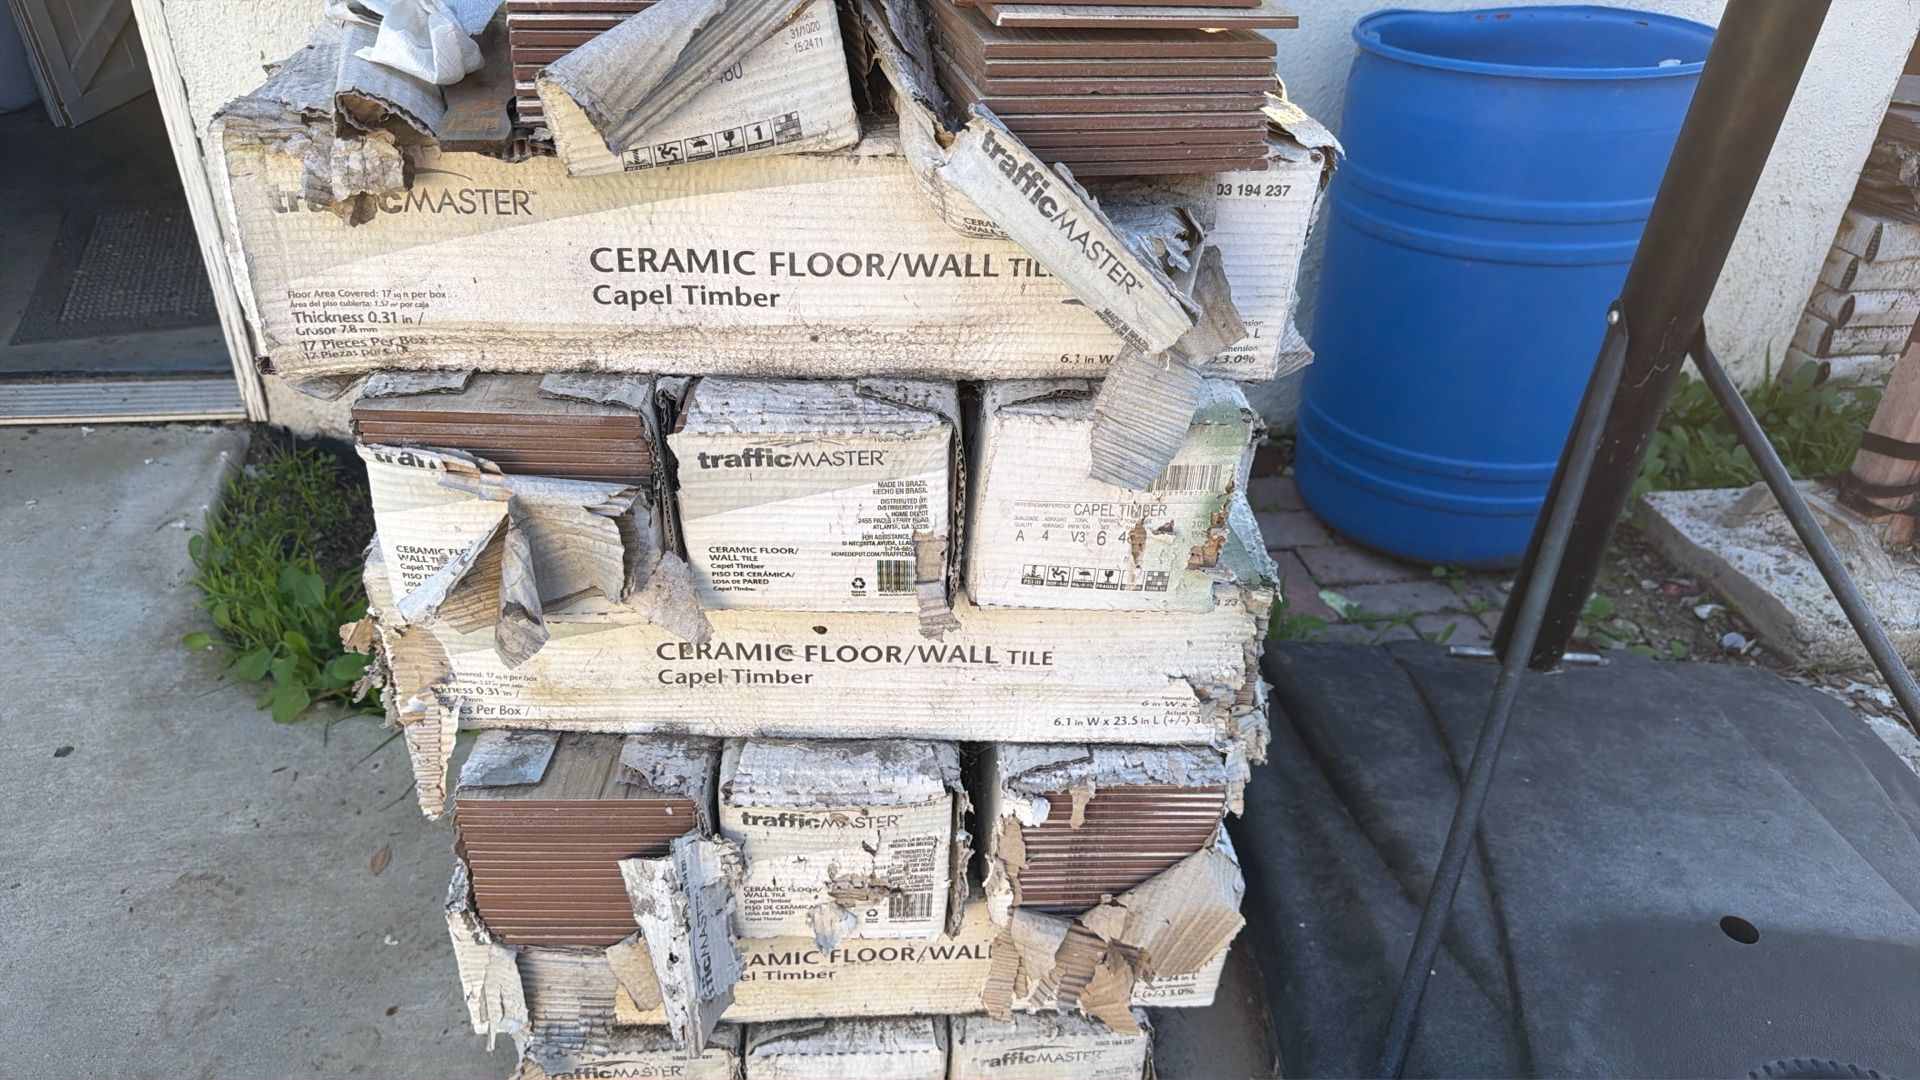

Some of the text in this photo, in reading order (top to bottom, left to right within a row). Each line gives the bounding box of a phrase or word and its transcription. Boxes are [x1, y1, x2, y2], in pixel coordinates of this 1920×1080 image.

[1237, 184, 1262, 197] 194
[1265, 184, 1292, 197] 237
[981, 128, 1139, 295] trafficMASTER
[589, 247, 756, 276] CERAMIC
[769, 250, 1000, 281] FLOOR/WALL
[288, 289, 447, 300] Floor Area Covered: 17 per box
[592, 284, 781, 312] Capel Timber
[309, 300, 321, 308] del
[323, 301, 339, 309] piso
[291, 310, 364, 325] Thickness
[368, 311, 398, 325] 0.31
[402, 314, 414, 325] in
[1103, 308, 1123, 326] MADE
[296, 326, 337, 336] Grosor
[340, 325, 358, 335] 7.8
[301, 340, 317, 352] 17
[321, 338, 367, 350] Pieces
[370, 336, 395, 348] Per
[321, 350, 359, 359] Piezas
[1084, 355, 1095, 365] in
[1099, 354, 1115, 364] W
[1221, 354, 1256, 364] 3.0%
[698, 448, 885, 469] trafficMASTER
[878, 480, 897, 488] MADE
[897, 480, 905, 488] IN
[872, 488, 895, 496] HECHO
[895, 487, 905, 495] EN
[1073, 502, 1168, 518] CAPEL TIMBER
[1015, 529, 1108, 546] A 4 V3 6
[708, 546, 799, 555] CERAMIC FLOOR/
[397, 553, 429, 563] WALL
[400, 563, 424, 571] Capel
[402, 572, 423, 580] PISO
[656, 642, 1055, 667] CERAMIC FLOOR/WALL TILE
[657, 668, 814, 688] Capel Timber
[476, 686, 500, 696] 0.31
[476, 704, 496, 715] Per
[500, 705, 522, 716] Box
[1053, 717, 1072, 727] 6.1
[1087, 717, 1100, 726] W
[1102, 718, 1110, 726] x
[1113, 716, 1138, 726] 23.5
[1141, 717, 1150, 725] in
[1153, 716, 1160, 725] L
[764, 969, 837, 981] Timber
